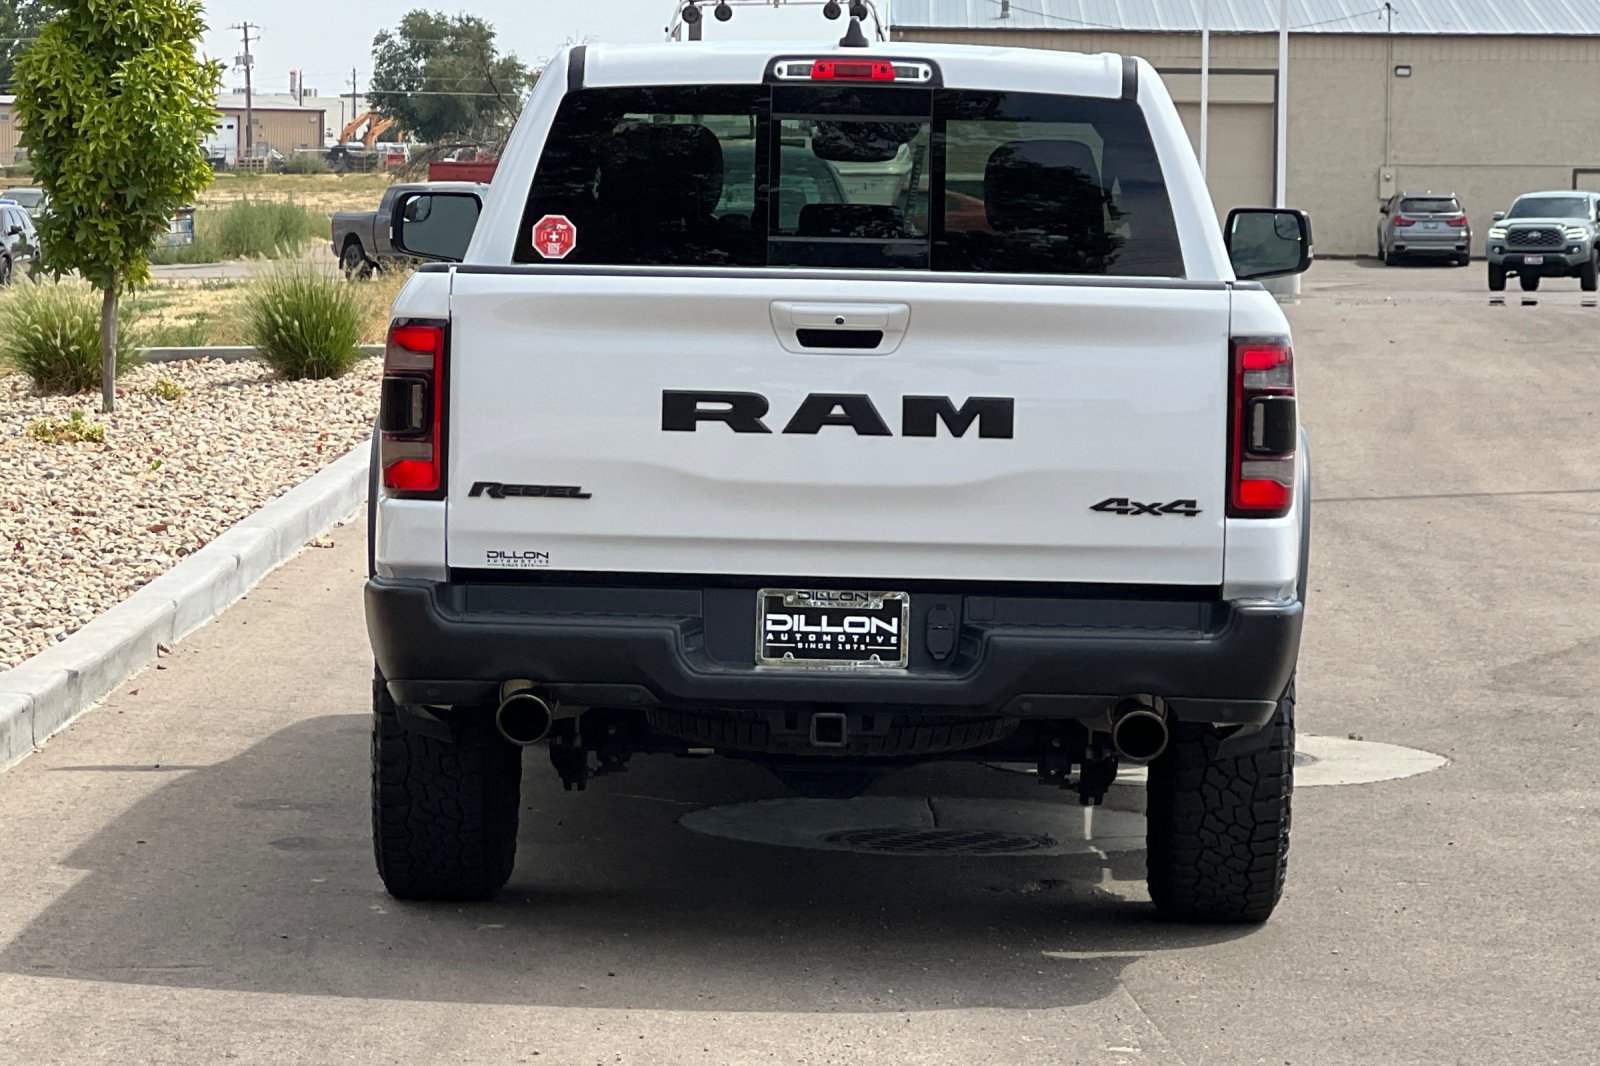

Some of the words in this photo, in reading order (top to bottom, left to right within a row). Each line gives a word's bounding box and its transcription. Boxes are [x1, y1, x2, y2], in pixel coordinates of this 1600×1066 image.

[661, 389, 1015, 439] RAM
[468, 481, 592, 499] REBEL
[486, 550, 549, 559] DILLON
[797, 590, 870, 602] DILLON
[765, 613, 899, 635] DILLON
[766, 633, 898, 644] AUTOMOTIVE
[797, 642, 831, 650] SINCE
